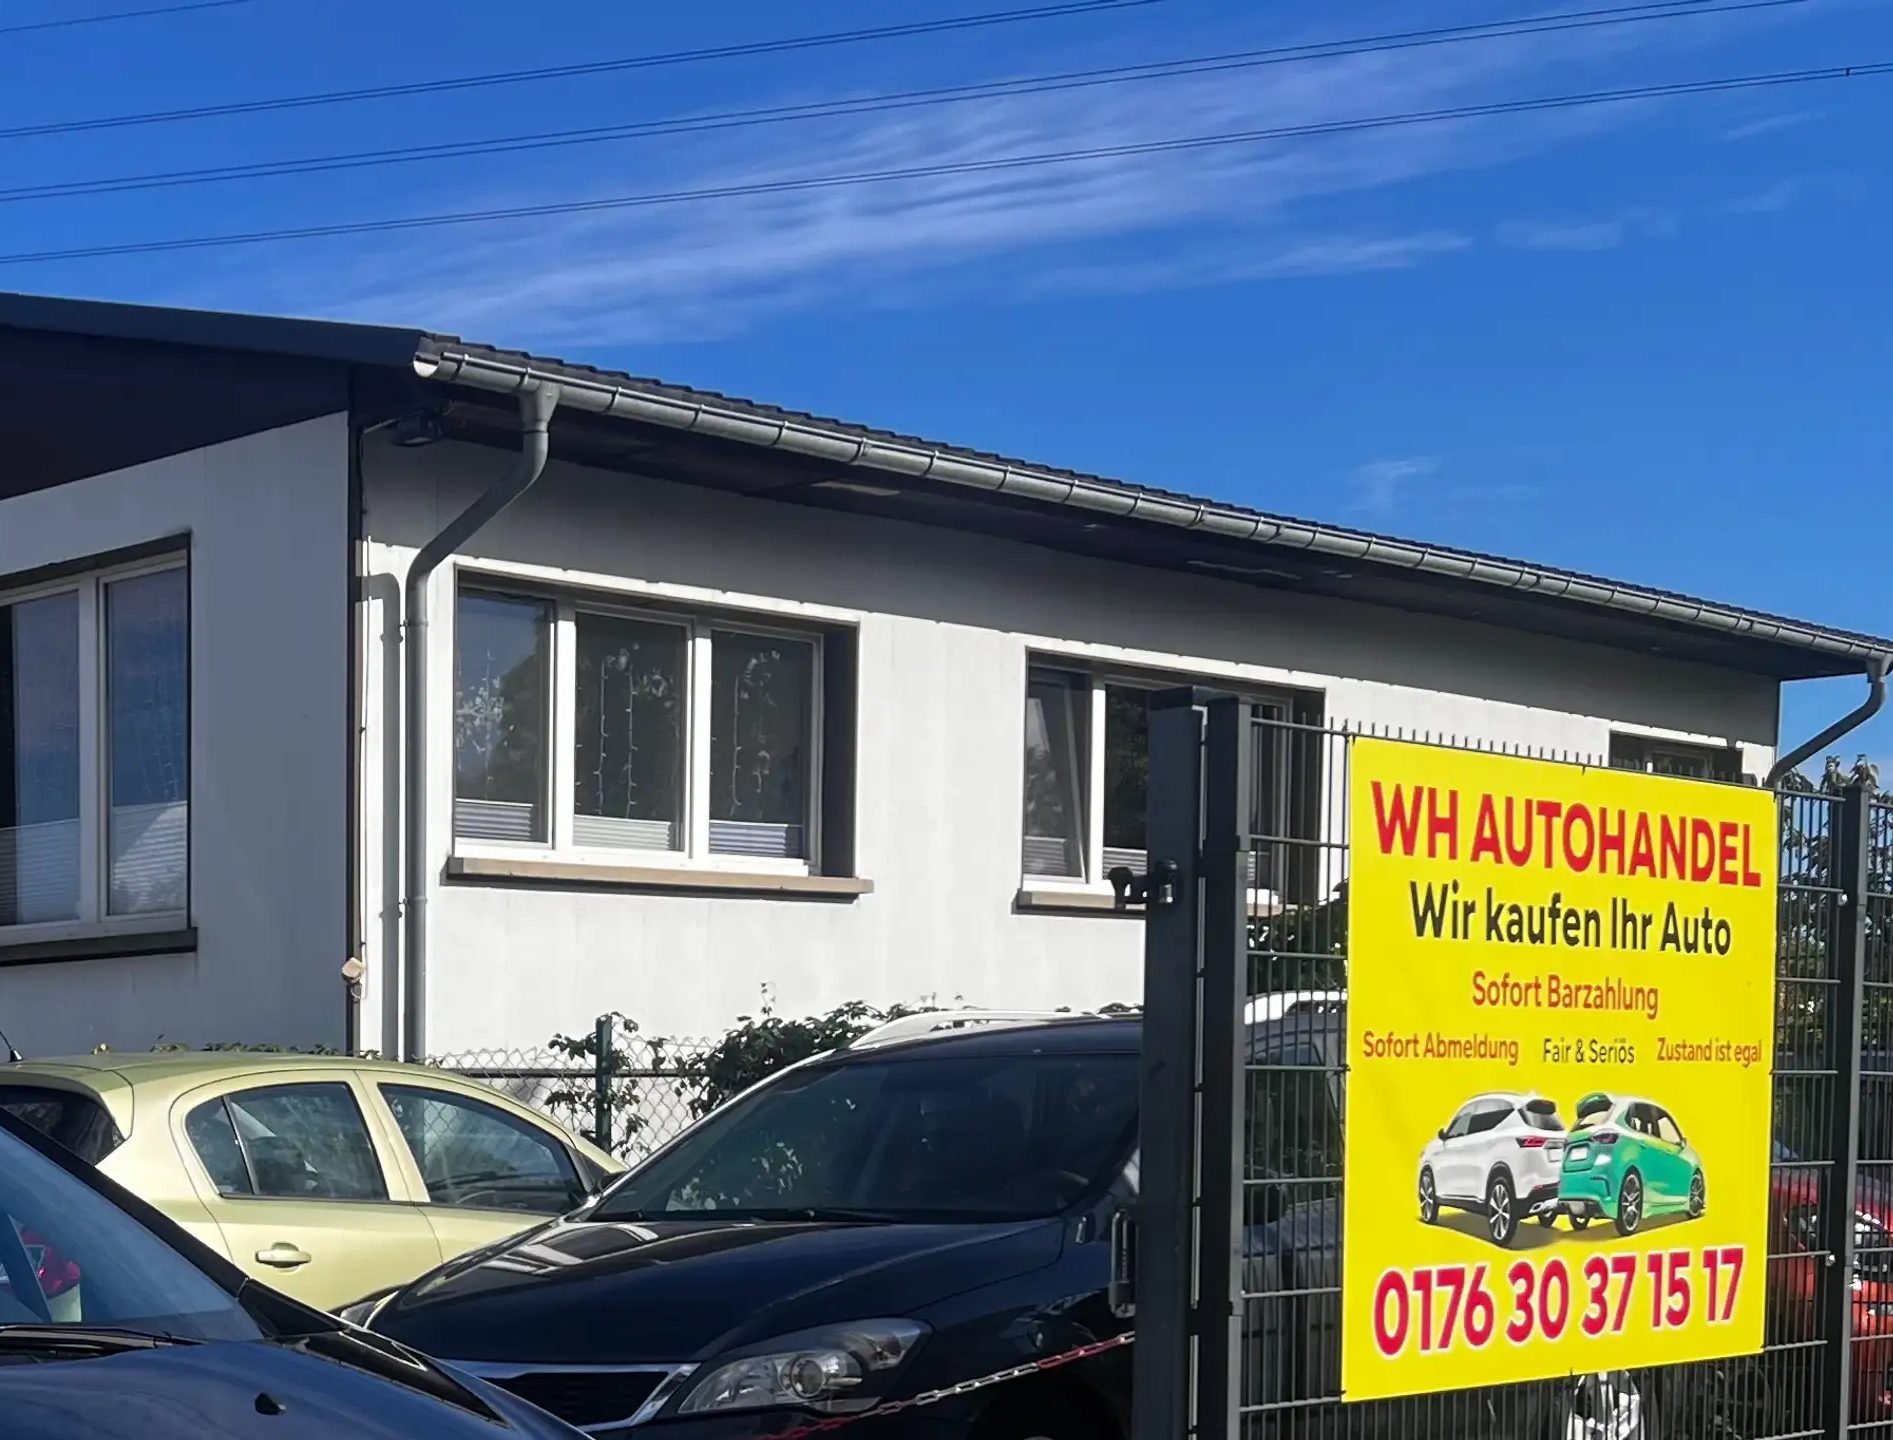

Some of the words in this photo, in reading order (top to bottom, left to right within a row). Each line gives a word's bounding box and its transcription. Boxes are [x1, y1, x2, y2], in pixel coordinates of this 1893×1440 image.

[1371, 781, 1458, 860] WH
[1470, 794, 1761, 887] AUTOHANDEL
[1410, 879, 1475, 939] Wir
[1486, 887, 1600, 947] kaufen
[1612, 897, 1652, 950] Ihr
[1660, 902, 1730, 955] Auto
[1472, 971, 1542, 1007] Sofort
[1548, 974, 1658, 1020] Barzahlung
[1363, 1031, 1419, 1058] Sofort
[1423, 1032, 1518, 1066] Abmeldung
[1543, 1037, 1571, 1062] Fair
[1575, 1039, 1585, 1063] &
[1589, 1038, 1634, 1064] Seriös
[1657, 1037, 1712, 1061] Zustand
[1715, 1040, 1732, 1061] ist
[1734, 1040, 1762, 1068] egal
[1374, 1266, 1494, 1355] 0176
[1506, 1260, 1569, 1342] 30
[1582, 1256, 1636, 1335] 37
[1647, 1252, 1690, 1327] 15
[1703, 1248, 1743, 1321] 17
